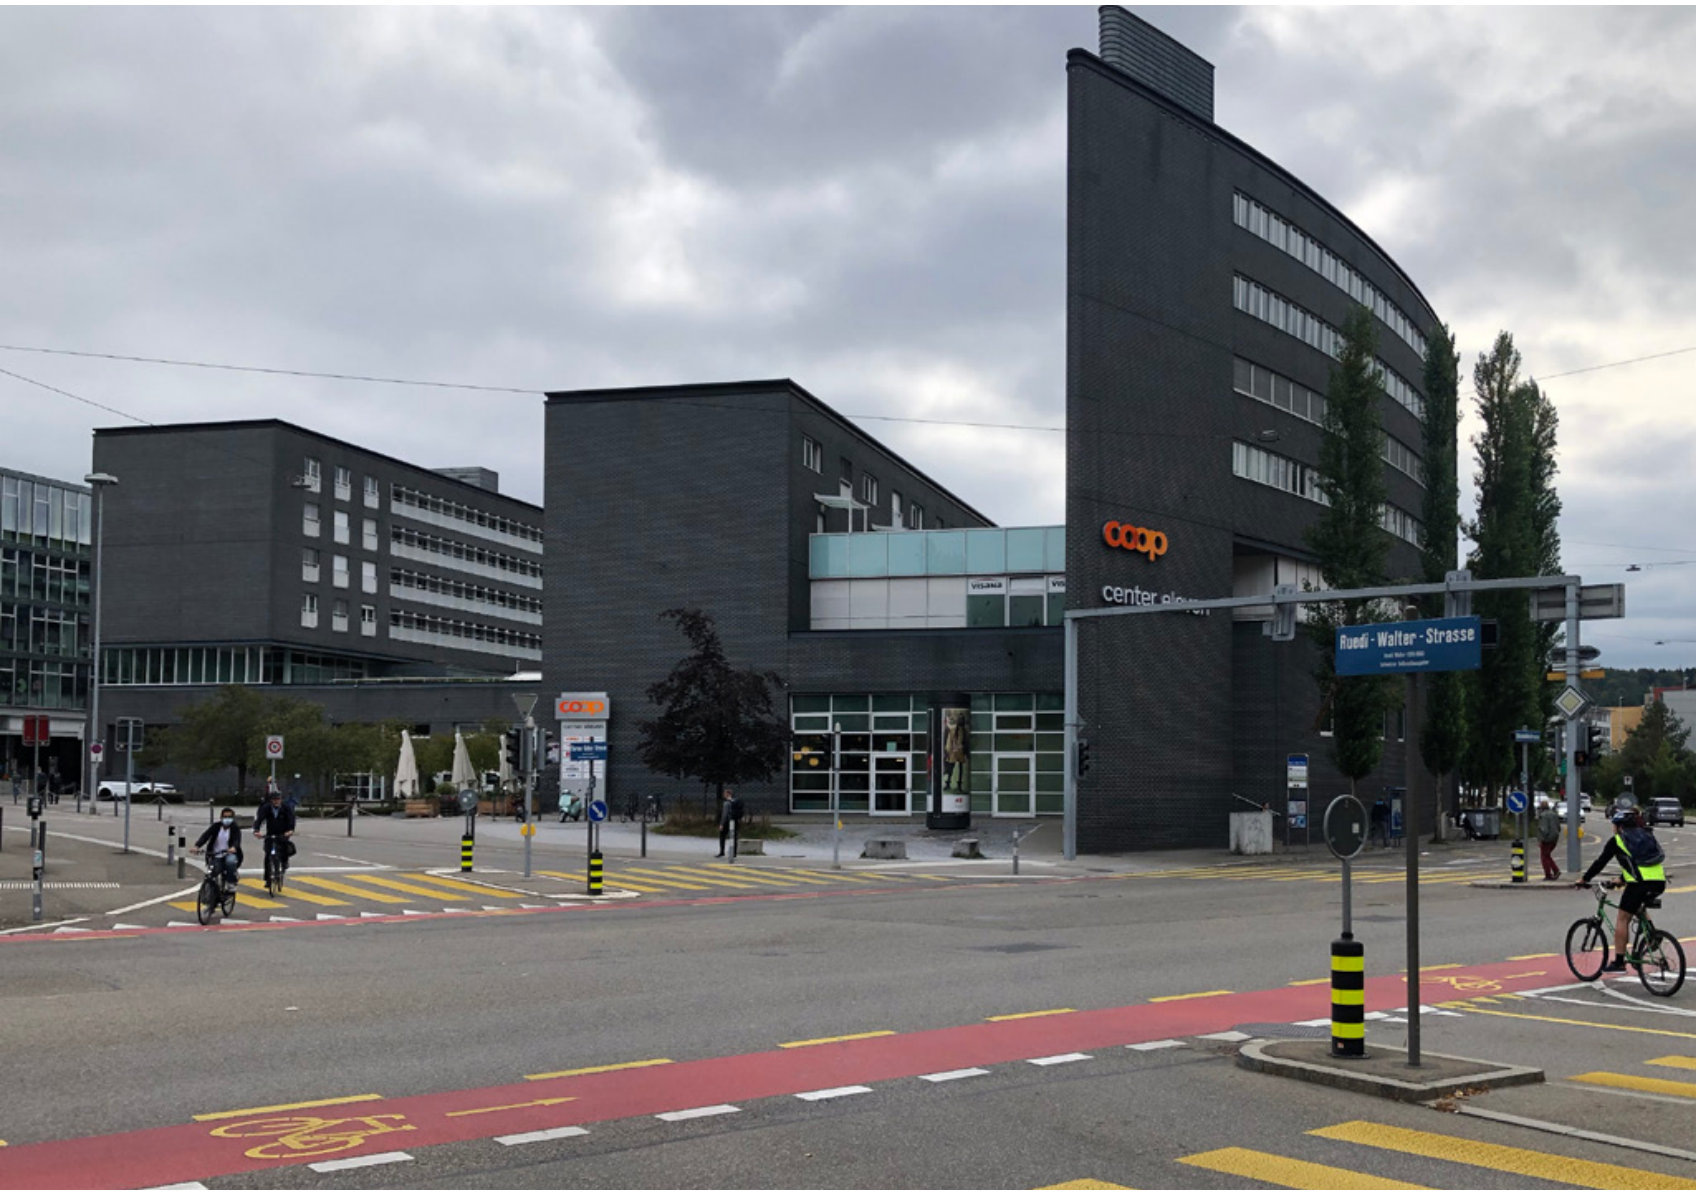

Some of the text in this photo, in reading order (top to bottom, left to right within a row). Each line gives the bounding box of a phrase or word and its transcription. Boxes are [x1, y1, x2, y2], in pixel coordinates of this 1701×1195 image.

[1103, 520, 1168, 561] coop
[1102, 585, 1157, 606] center
[1426, 627, 1475, 644] Strasse
[559, 701, 604, 716] coop
